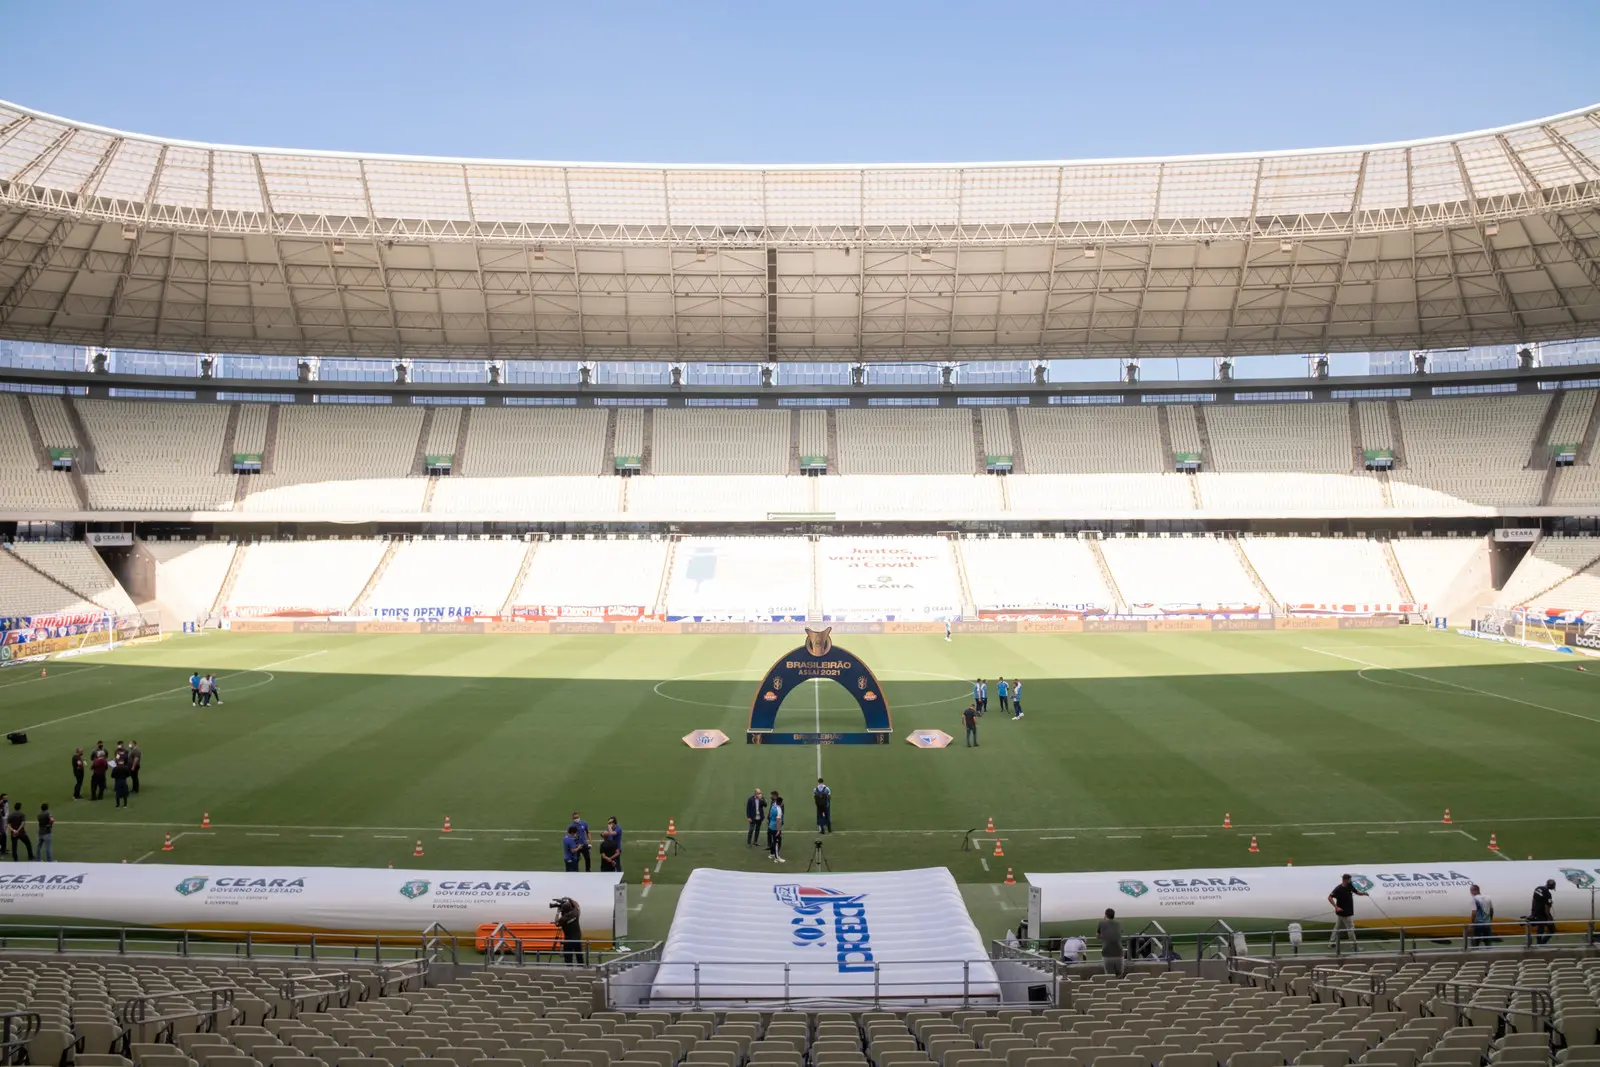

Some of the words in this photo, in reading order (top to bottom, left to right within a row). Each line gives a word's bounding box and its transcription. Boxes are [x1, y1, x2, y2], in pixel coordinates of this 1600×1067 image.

[25, 641, 56, 656] betfair
[786, 661, 852, 669] BRASILEIRÃO
[0, 873, 88, 884] CEARÁ
[216, 876, 308, 887] CEARÁ
[1153, 876, 1248, 887] CEARÁ
[1376, 870, 1470, 882] CEARÁ
[439, 880, 531, 890] CEARÁ
